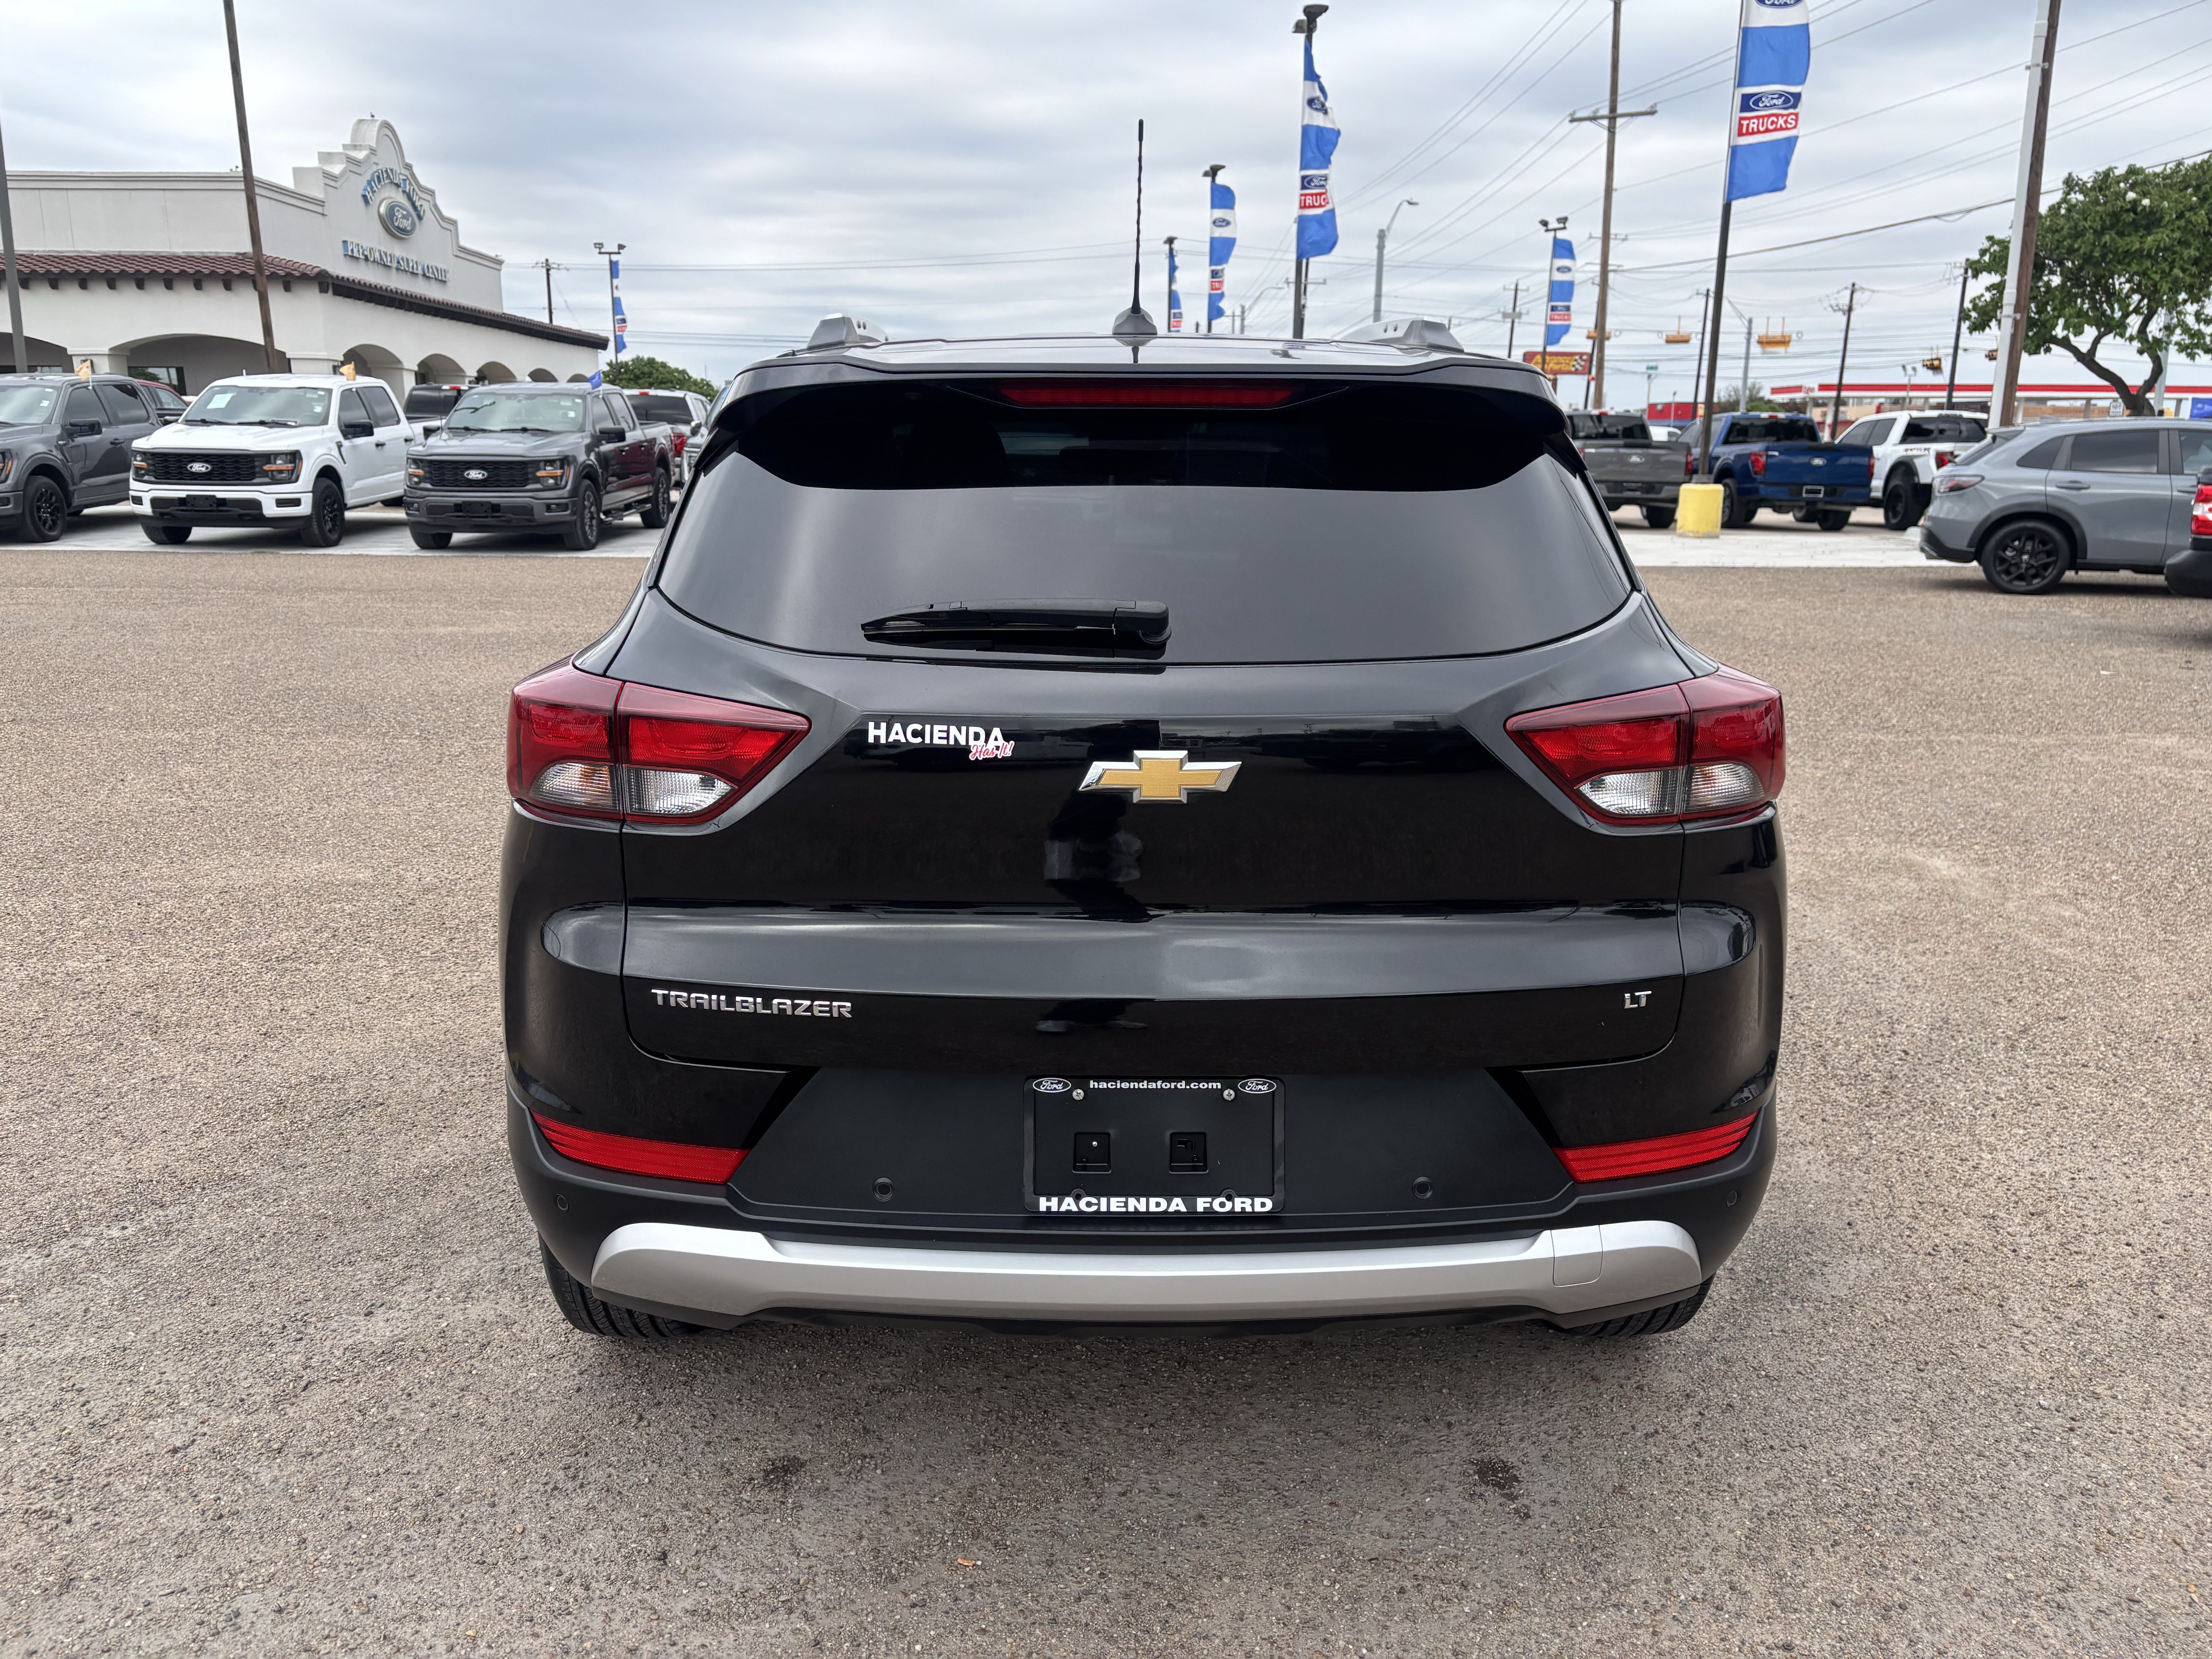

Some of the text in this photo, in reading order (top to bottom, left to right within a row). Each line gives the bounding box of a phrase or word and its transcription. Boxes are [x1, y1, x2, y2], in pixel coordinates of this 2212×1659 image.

[1759, 94, 1785, 107] Ford
[1741, 115, 1796, 134] TRUCKS
[1310, 177, 1327, 187] For
[1300, 194, 1328, 208] TRUC
[393, 206, 412, 230] Ford
[868, 721, 1006, 748] HACIENDA
[970, 742, 1014, 759] Has It!
[651, 989, 852, 1018] TRAILBLAZER
[1623, 991, 1652, 1009] LT
[1040, 1079, 1063, 1090] Ford
[1089, 1080, 1221, 1089] haciendaford.com
[1245, 1081, 1269, 1091] Ford
[1039, 1197, 1273, 1212] HACIENDA FORD
